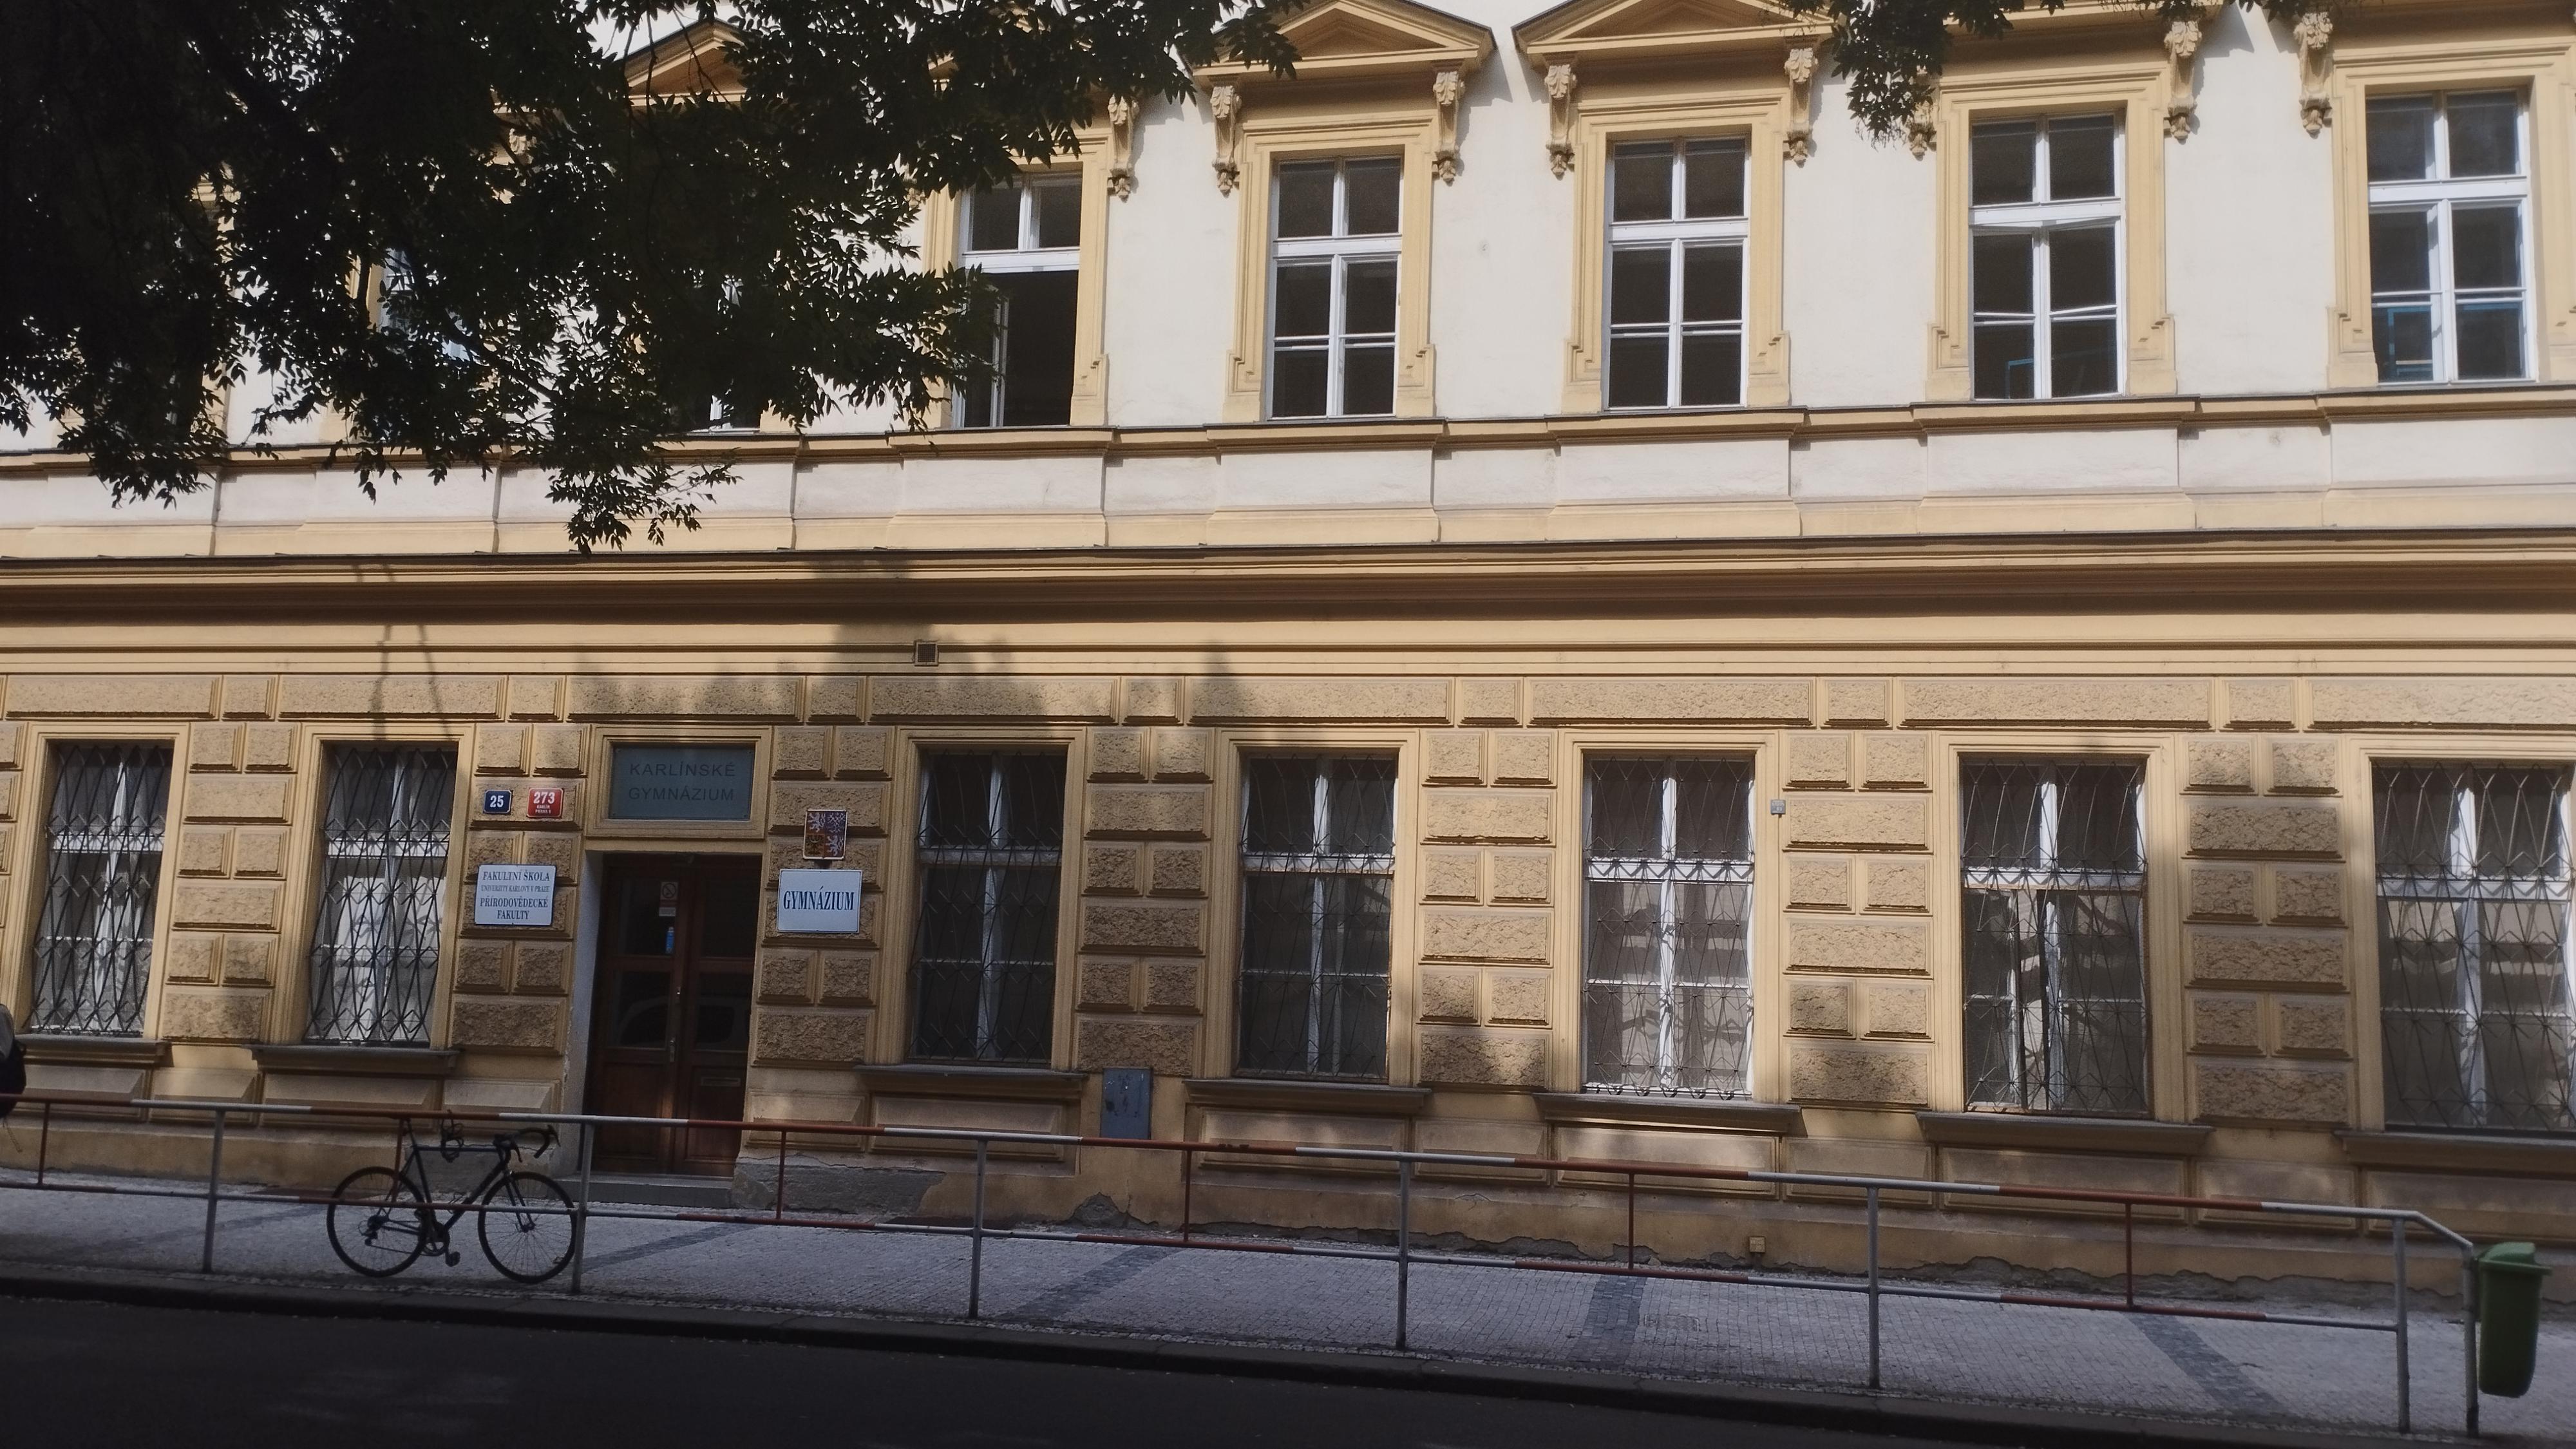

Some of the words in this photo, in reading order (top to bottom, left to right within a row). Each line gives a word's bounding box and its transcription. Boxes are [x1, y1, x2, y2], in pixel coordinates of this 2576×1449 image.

[630, 761, 735, 777] KARLÍNSKÉ
[533, 791, 555, 804] 273
[629, 785, 734, 801] GYMNÁZIUM
[489, 795, 504, 808] 25
[524, 869, 550, 881] ŠKOLA
[480, 895, 548, 907] PŘÍRODOVĚDECKÉ
[783, 886, 855, 910] GYMNÁZIUM
[497, 909, 529, 920] FAKULTY
